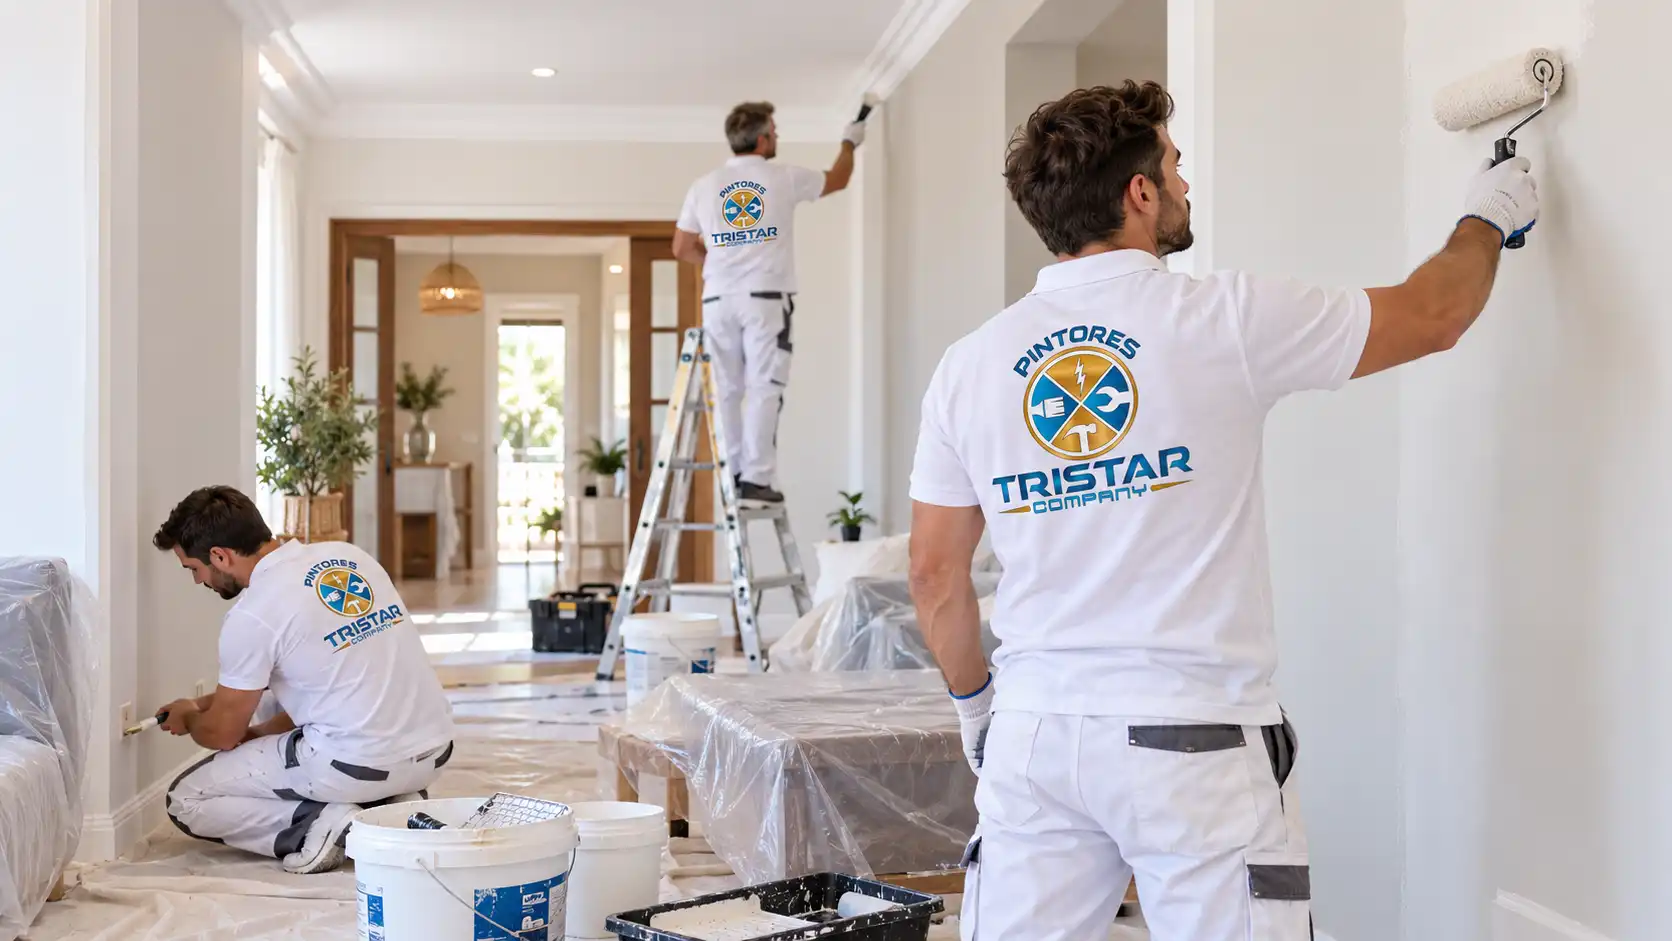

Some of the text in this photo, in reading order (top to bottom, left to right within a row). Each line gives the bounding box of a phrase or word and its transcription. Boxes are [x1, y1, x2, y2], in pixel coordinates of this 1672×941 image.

[719, 180, 767, 198] PINTORES
[711, 226, 778, 243] TRISTAR
[1013, 325, 1141, 378] PINTORES
[992, 446, 1194, 503] TRISTAR
[1033, 484, 1147, 514] COMPANY
[304, 559, 357, 587] PINTORES
[323, 604, 403, 647] TRISTAR
[351, 622, 392, 645] COMPANY
